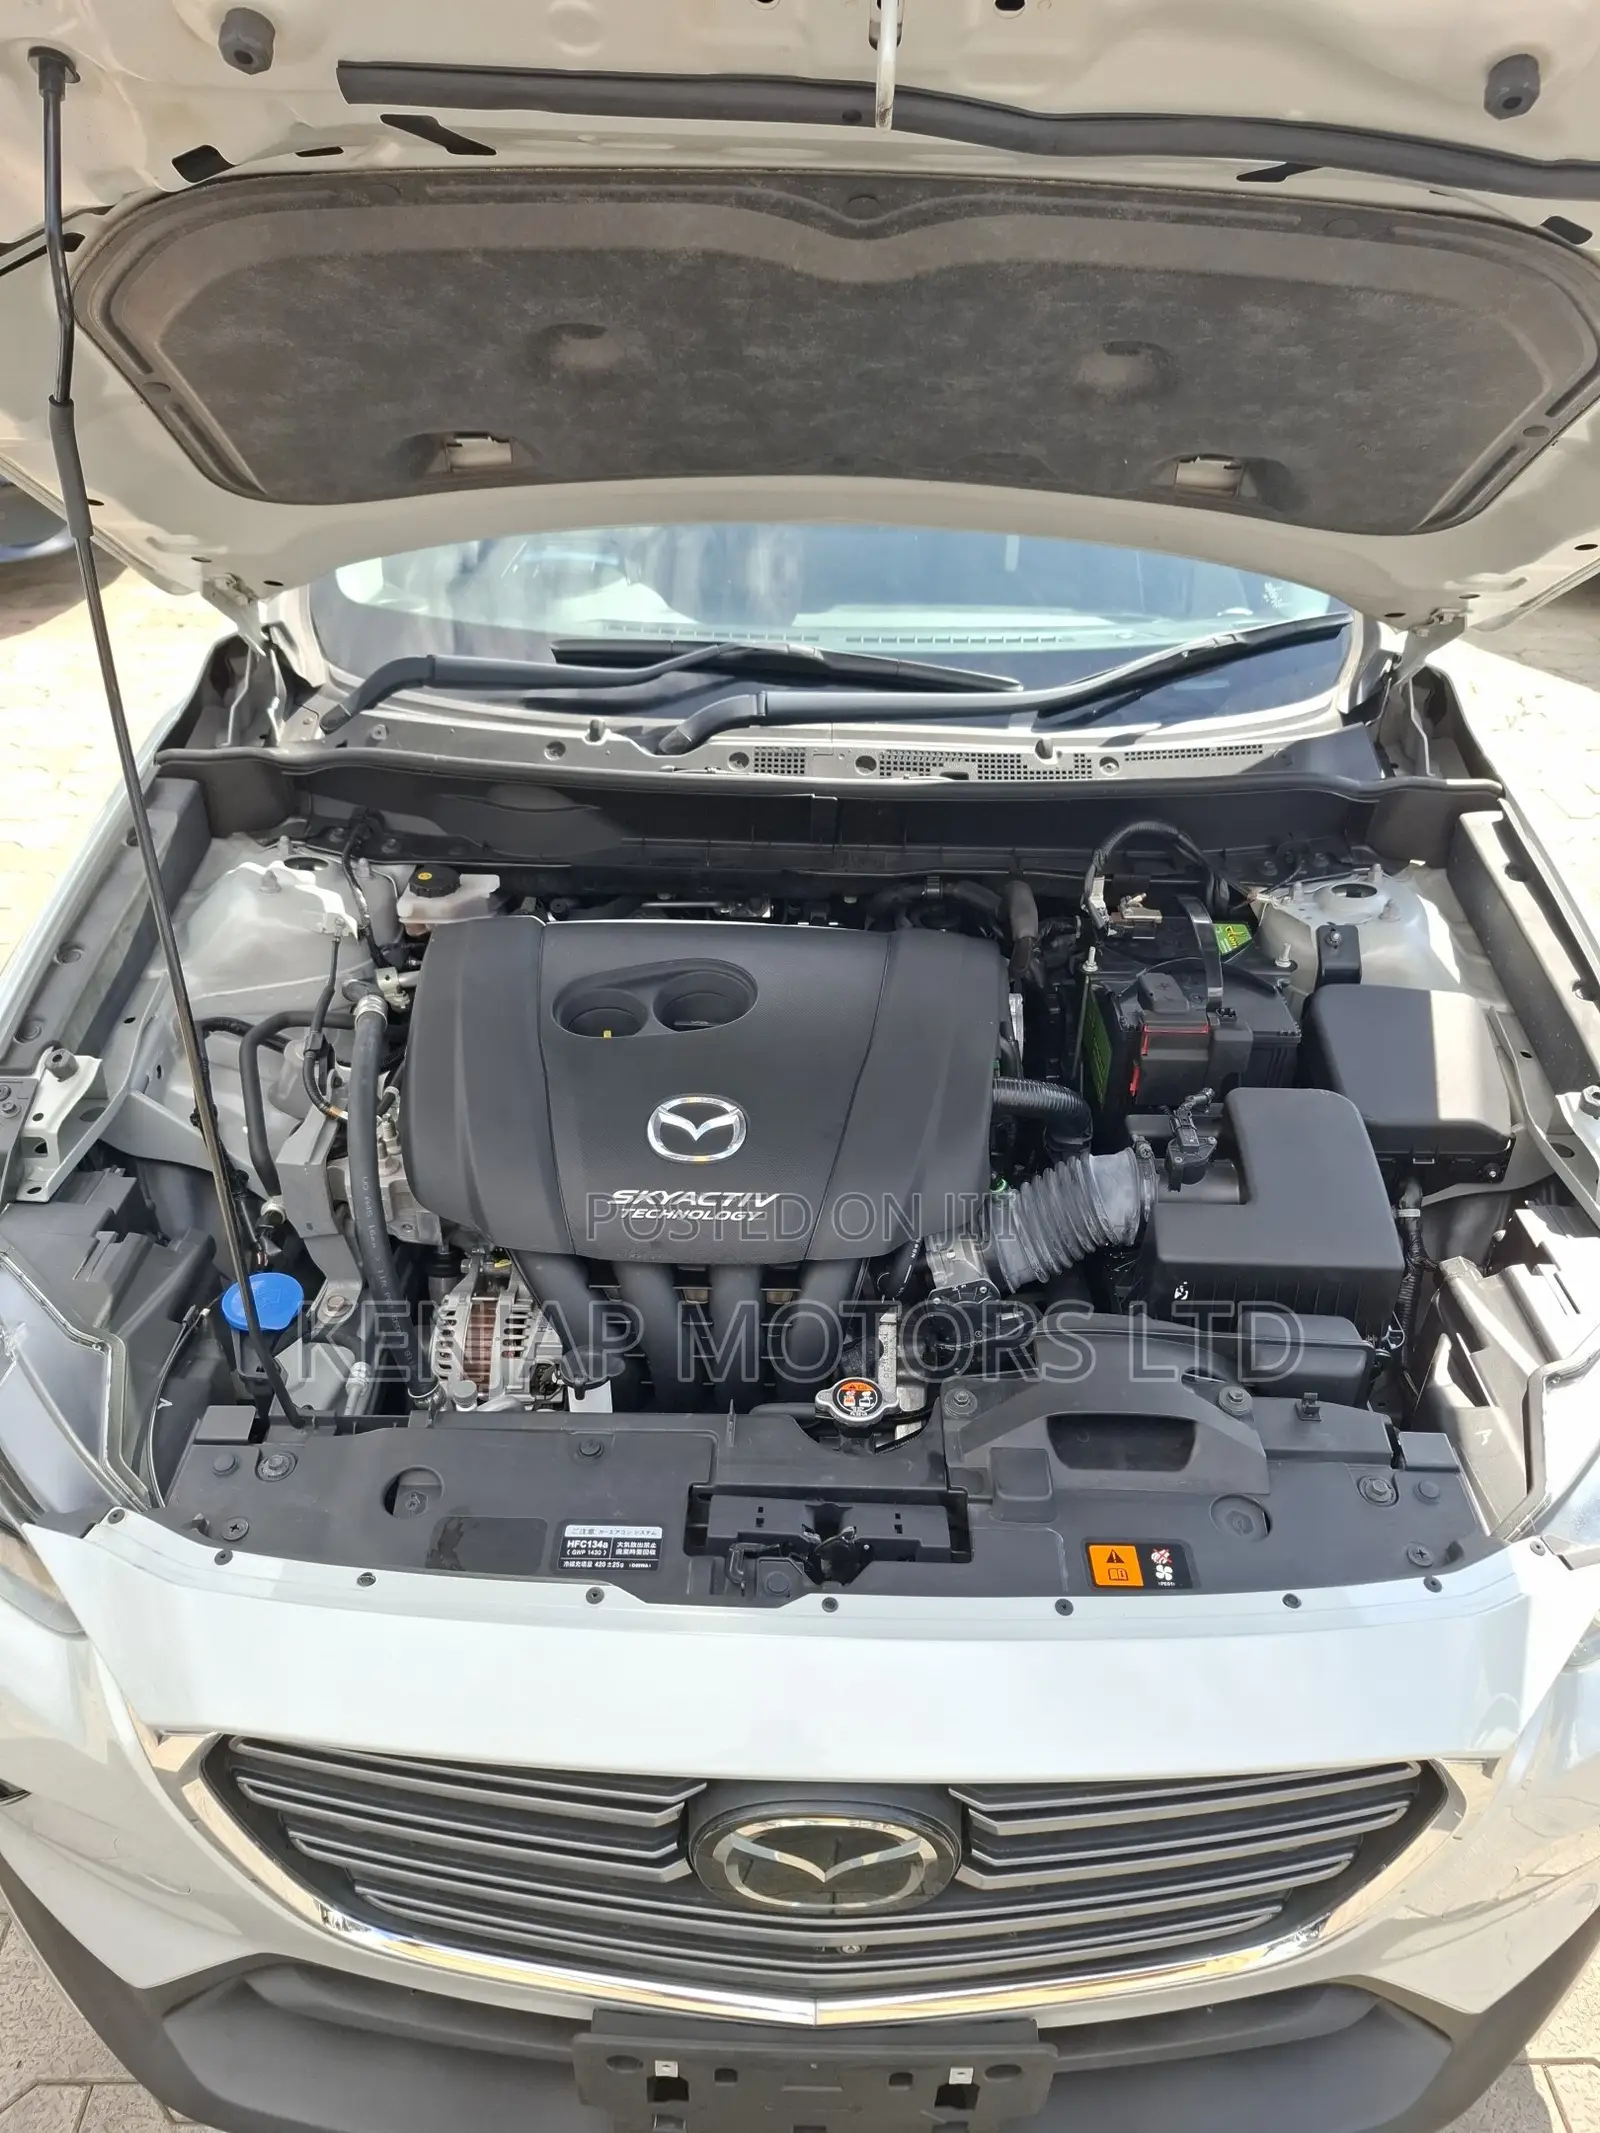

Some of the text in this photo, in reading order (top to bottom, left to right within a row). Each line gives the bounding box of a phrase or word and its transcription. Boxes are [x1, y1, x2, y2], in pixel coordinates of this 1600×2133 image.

[607, 1189, 780, 1208] SKYACTIV
[620, 1208, 764, 1222] TECHNOLOGY
[567, 1540, 609, 1549] HFC134a
